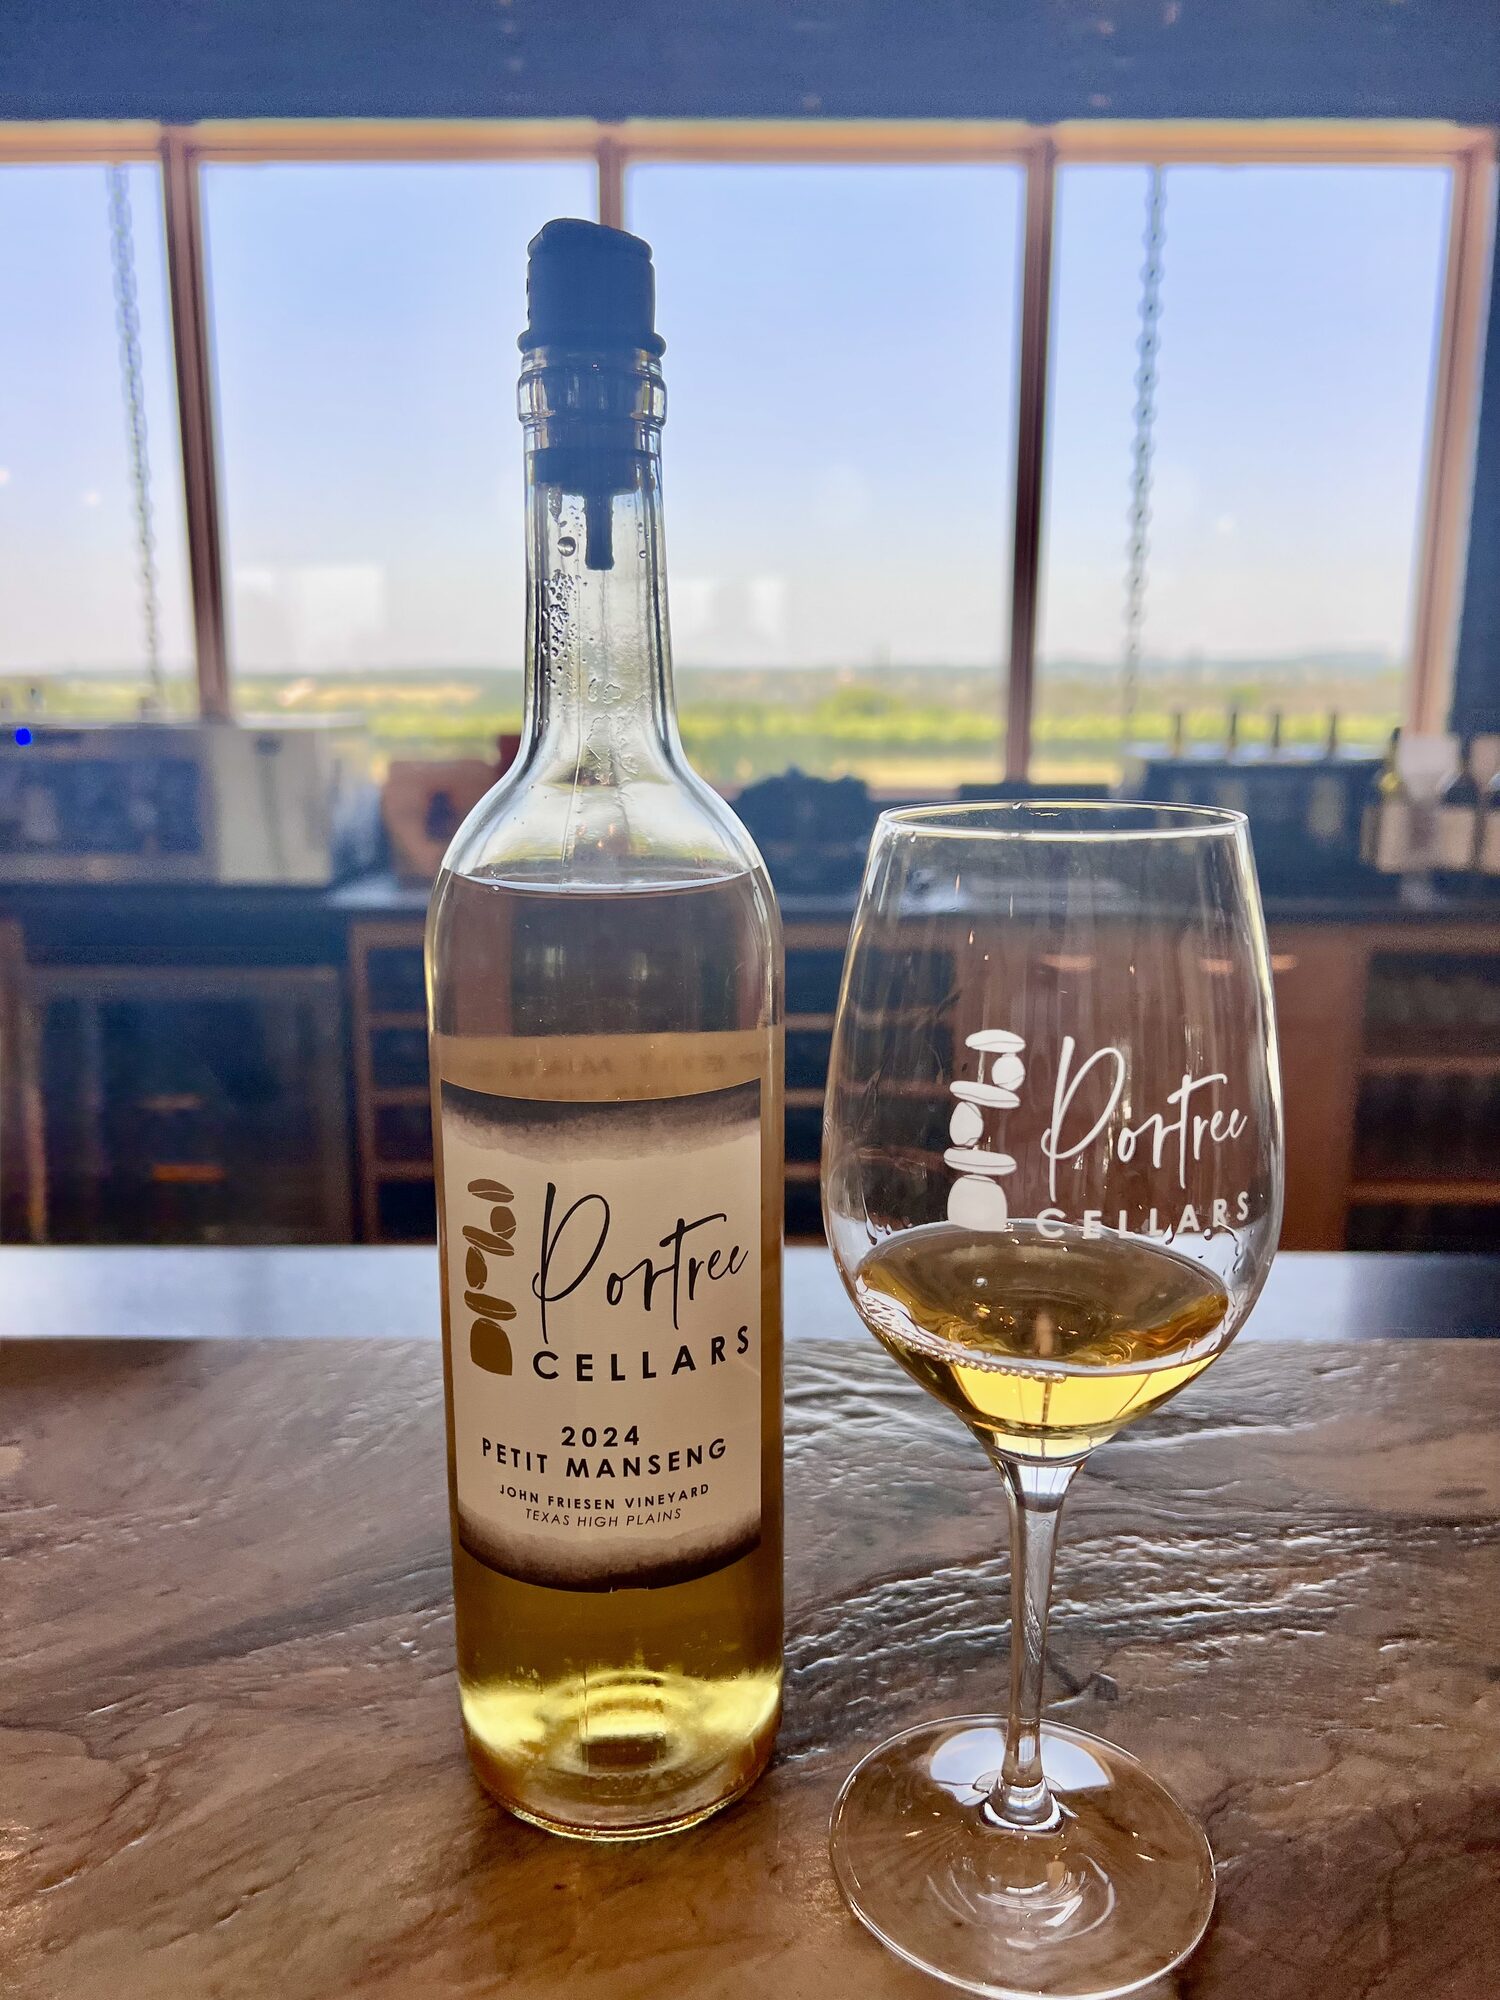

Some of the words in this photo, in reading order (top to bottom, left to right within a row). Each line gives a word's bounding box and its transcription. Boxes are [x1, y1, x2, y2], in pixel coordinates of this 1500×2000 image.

[1040, 1036, 1248, 1203] Portree
[1036, 1191, 1249, 1240] CELLARS
[532, 1182, 749, 1345] Portree
[532, 1325, 749, 1382] CELLARS
[482, 1437, 548, 1474] PETIT
[565, 1438, 726, 1478] MANSENG
[561, 1425, 640, 1448] 2024
[500, 1484, 539, 1504] JOHN
[548, 1495, 615, 1510] FRIESEN
[624, 1483, 710, 1509] VINEYARD
[525, 1508, 570, 1526] TEXAS
[577, 1516, 618, 1528] HIGH
[626, 1508, 682, 1526] PLAINS
